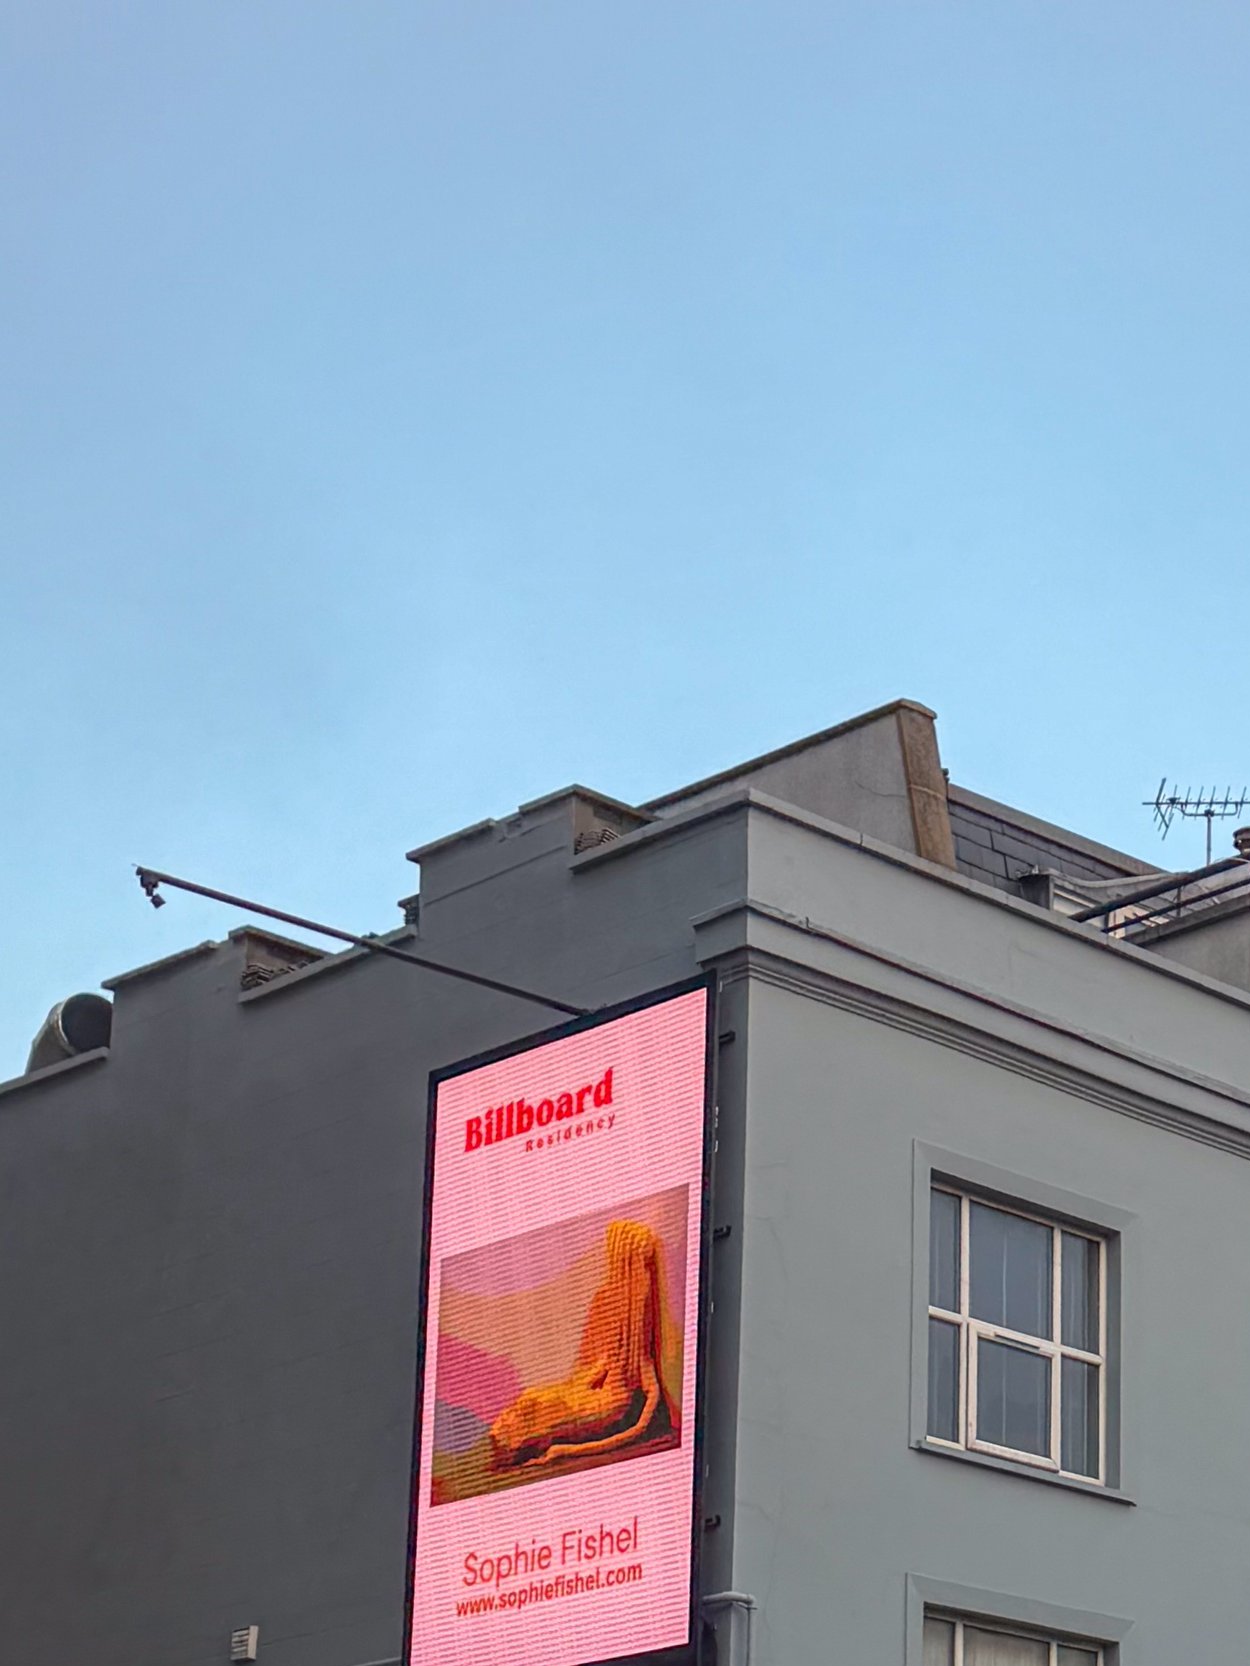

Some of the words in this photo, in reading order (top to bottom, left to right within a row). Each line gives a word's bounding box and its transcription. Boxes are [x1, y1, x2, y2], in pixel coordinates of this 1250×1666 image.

[464, 1066, 613, 1152] Billboard
[525, 1114, 615, 1152] Residency
[462, 1540, 552, 1589] Sophie
[561, 1515, 638, 1565] Fishel
[456, 1563, 643, 1617] www.sophiefishel.com
